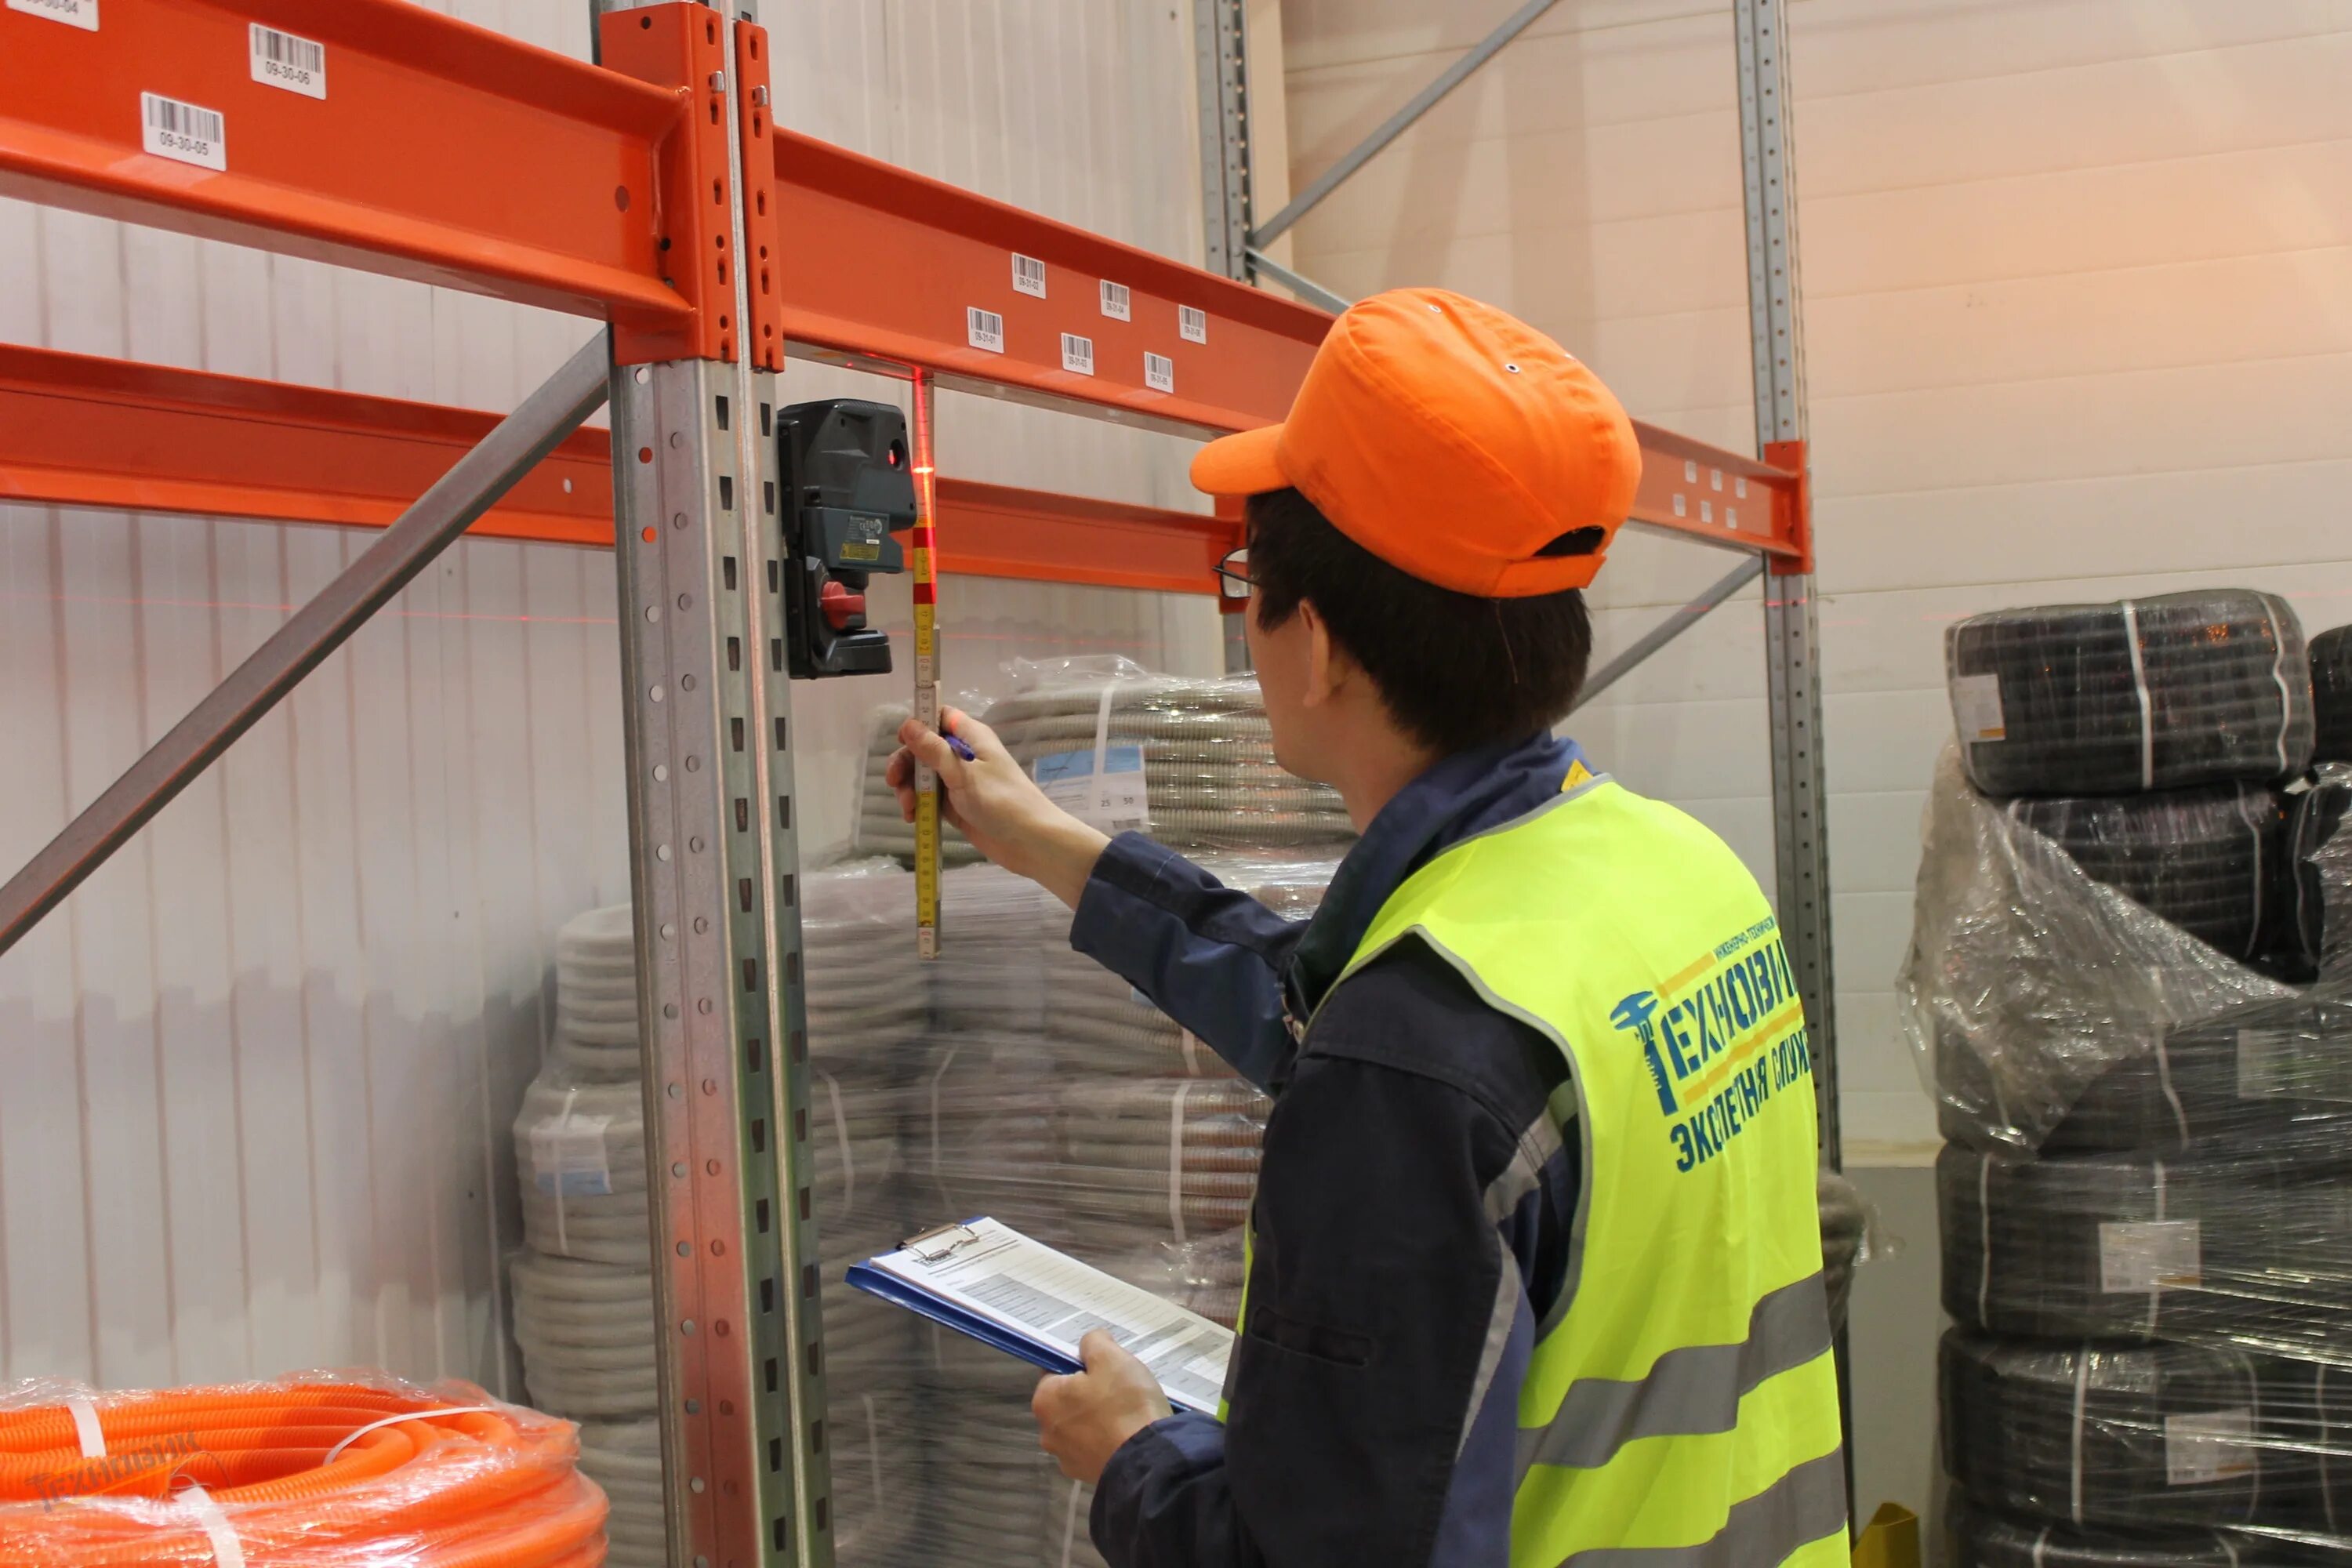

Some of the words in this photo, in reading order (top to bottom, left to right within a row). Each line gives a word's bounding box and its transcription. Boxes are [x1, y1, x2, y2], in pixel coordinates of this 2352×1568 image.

[265, 60, 310, 85] 09-30-06
[159, 131, 209, 156] 09-30-05
[975, 330, 996, 344] 09-31-01
[1123, 797, 1134, 805] 50
